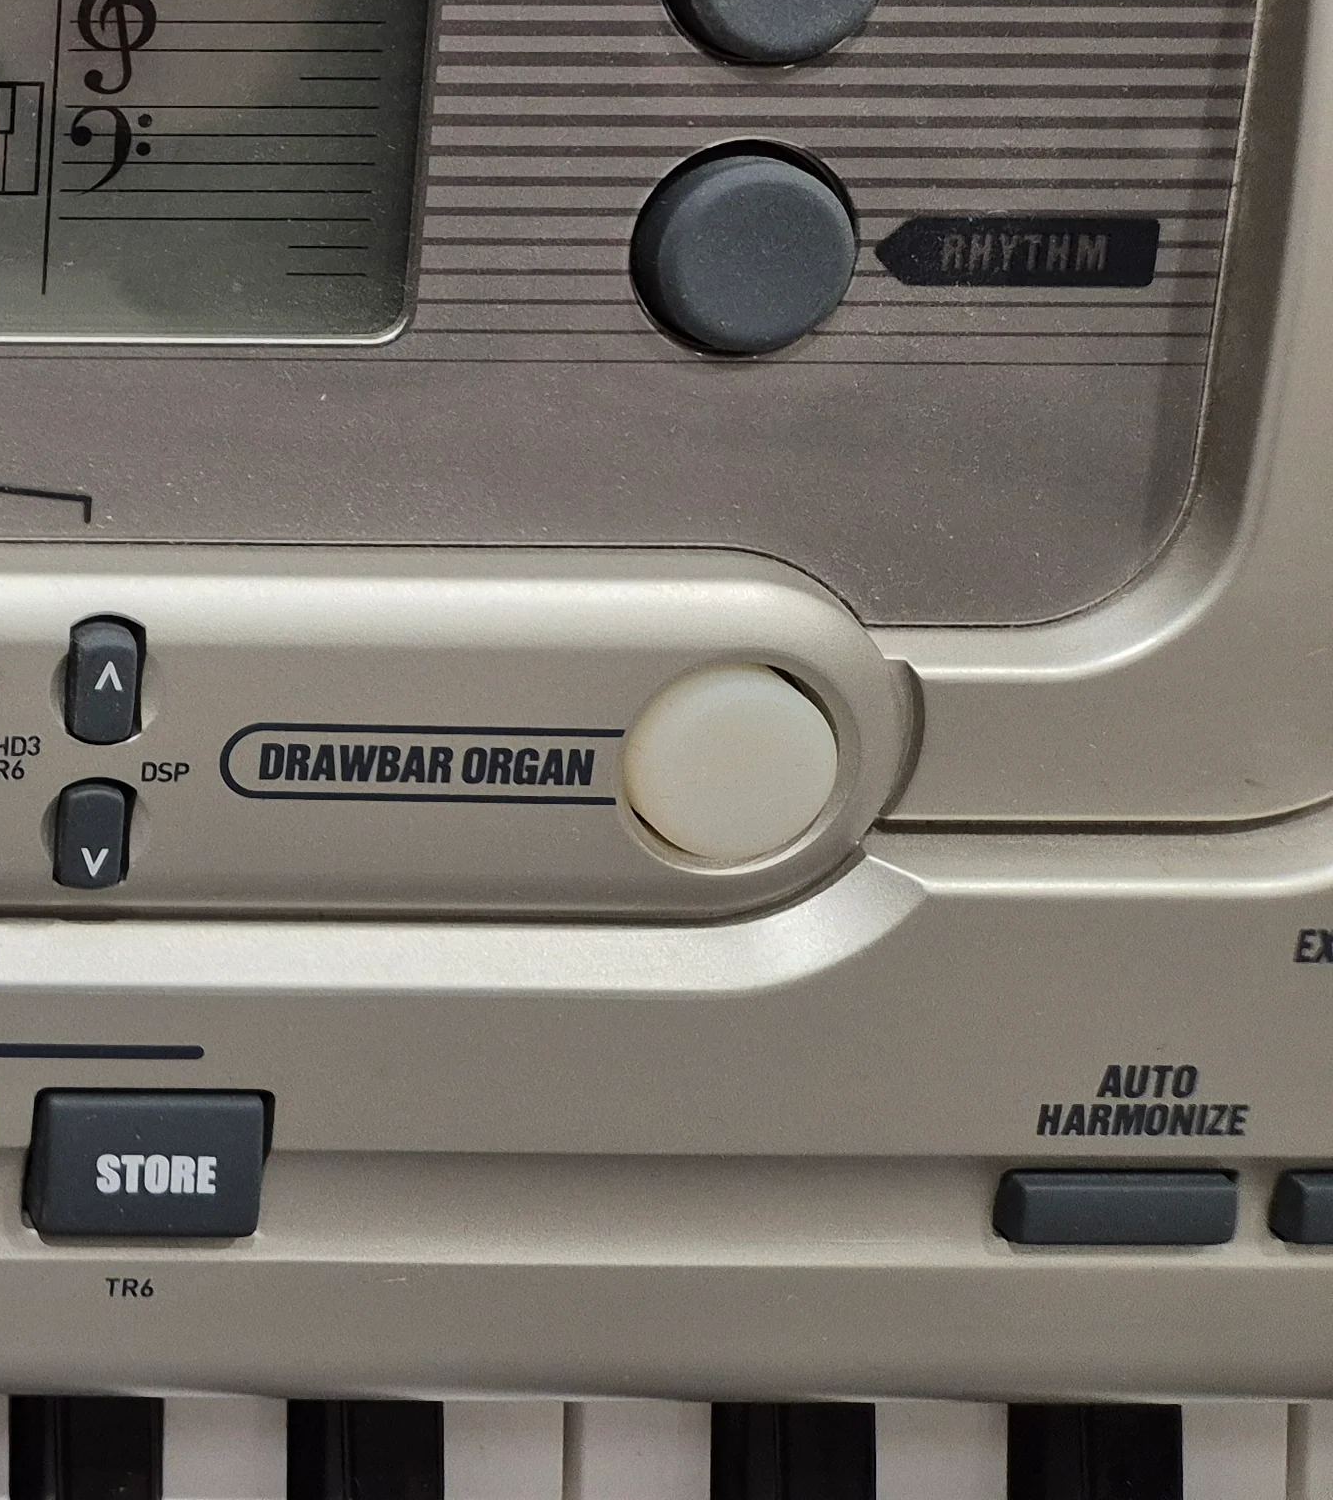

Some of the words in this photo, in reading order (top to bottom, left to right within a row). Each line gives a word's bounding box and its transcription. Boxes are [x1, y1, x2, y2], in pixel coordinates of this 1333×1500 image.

[940, 232, 1107, 275] RHYTHM
[141, 761, 190, 783] DSP
[258, 743, 454, 784] DRAWBAR
[461, 746, 595, 786] ORGAN
[1096, 1064, 1198, 1099] AUTO
[1036, 1103, 1249, 1137] HARMONIZE
[96, 1153, 217, 1195] STORE
[106, 1277, 154, 1298] TR6
